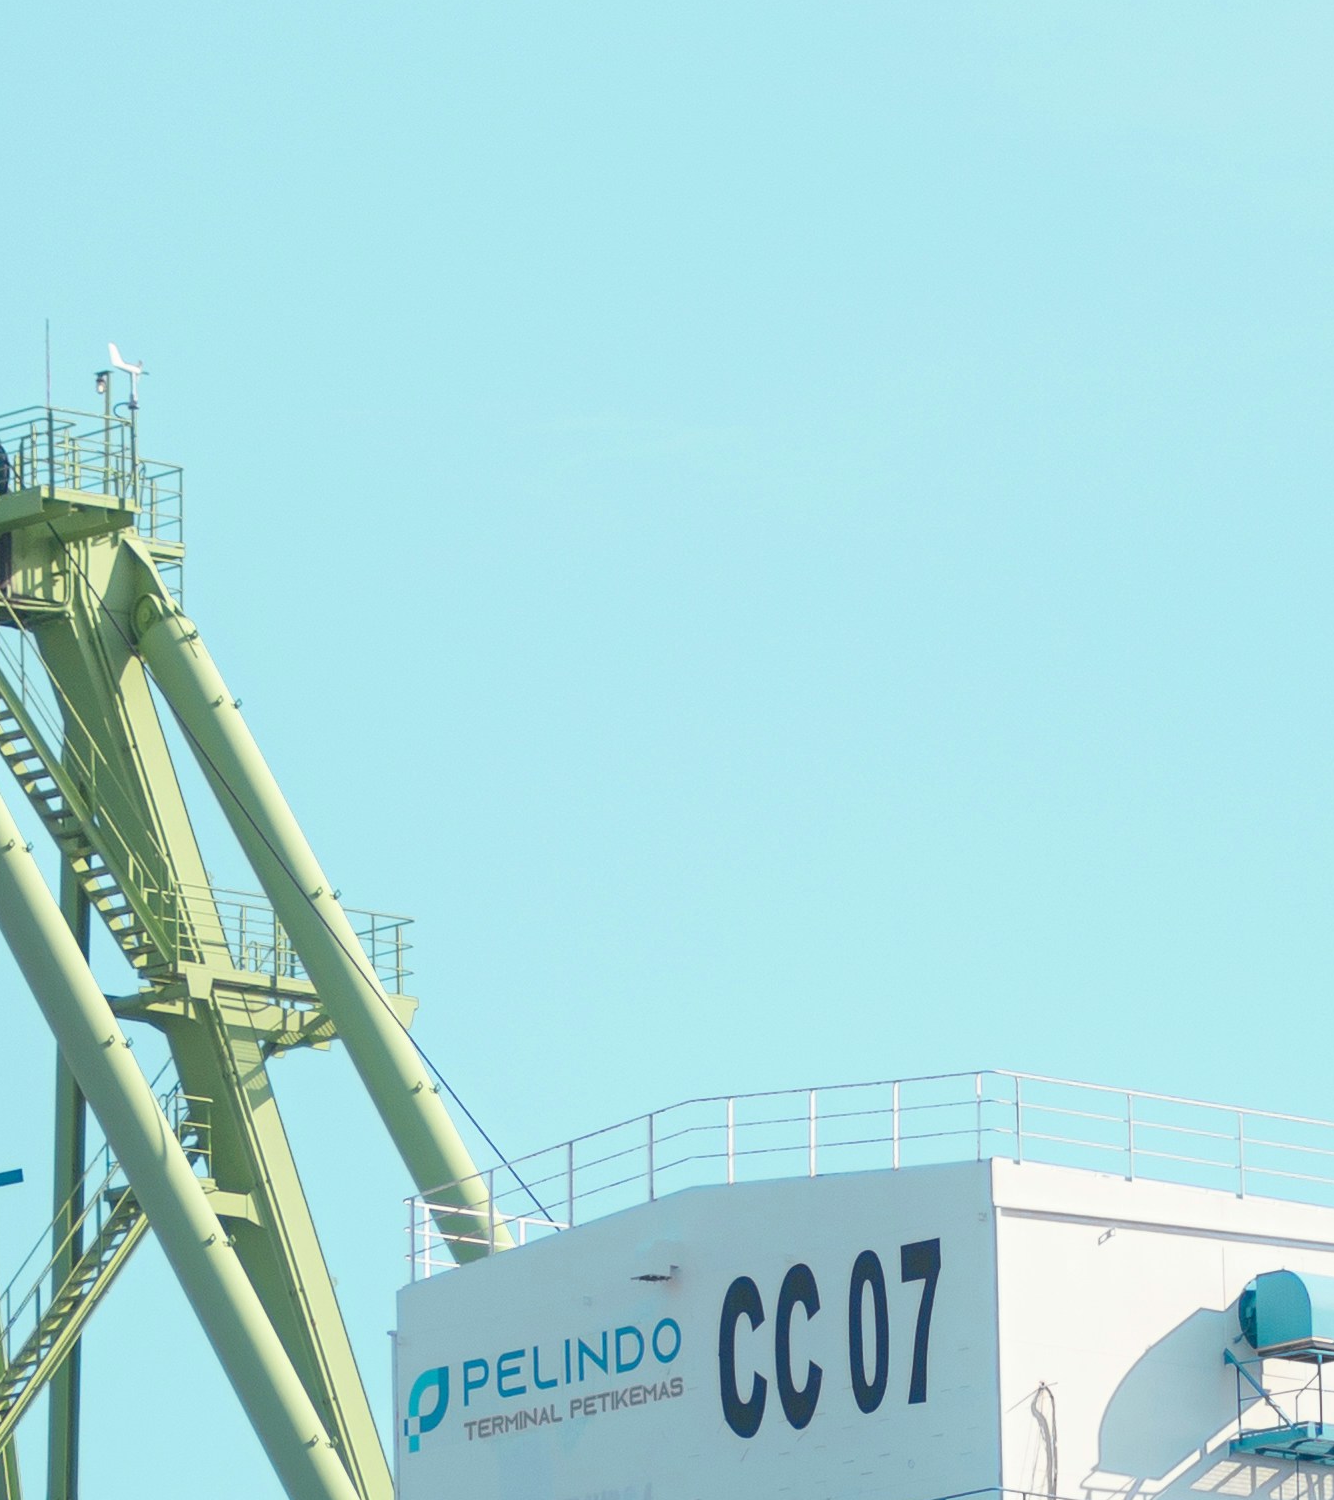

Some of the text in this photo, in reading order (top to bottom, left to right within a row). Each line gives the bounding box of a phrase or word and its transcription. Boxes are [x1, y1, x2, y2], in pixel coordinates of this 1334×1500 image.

[463, 1317, 682, 1407] PELINDO
[718, 1237, 941, 1438] CC 07
[463, 1377, 684, 1441] TERMINAL PETIKEMAS
